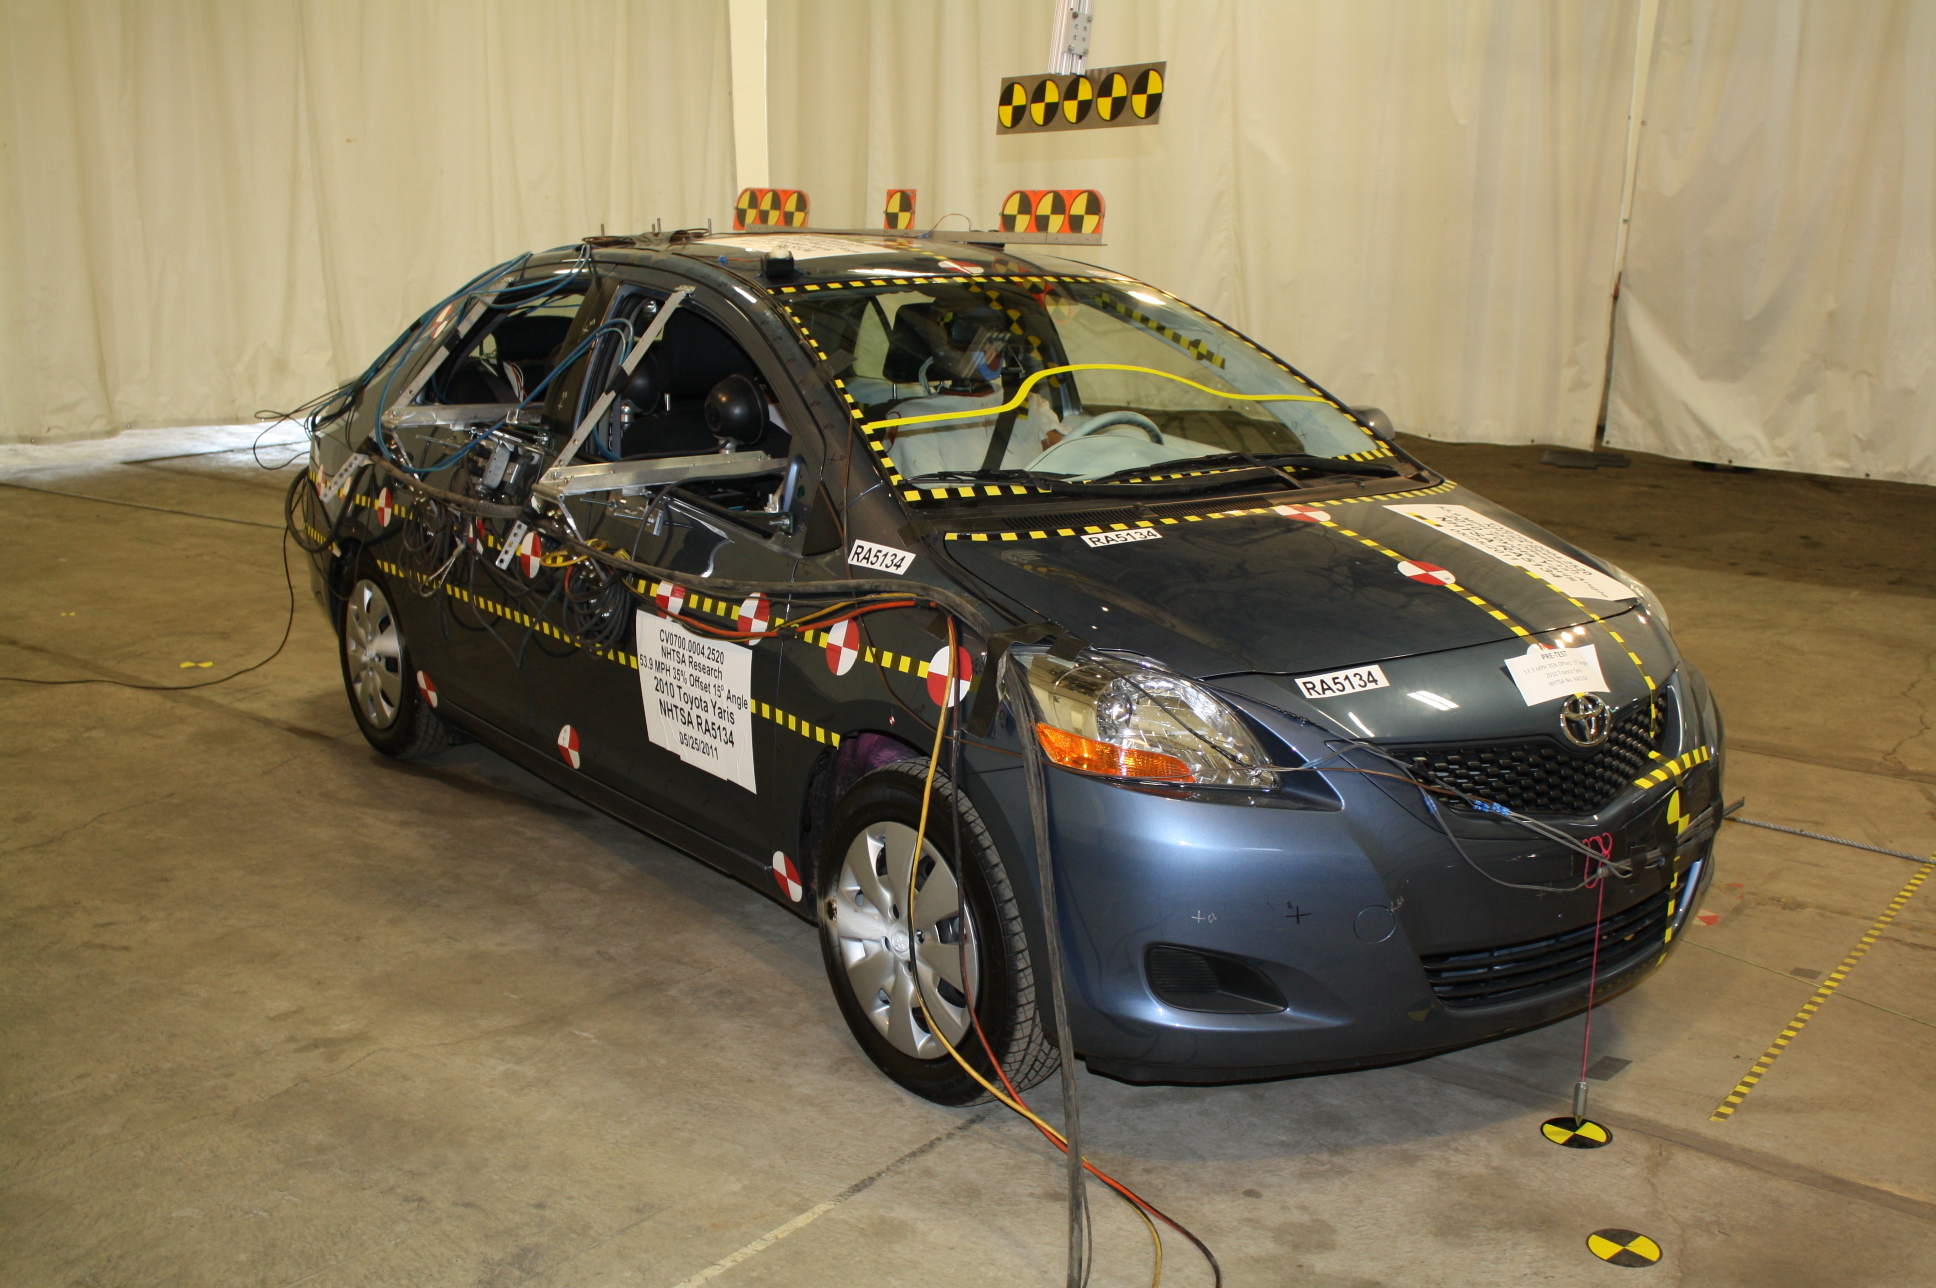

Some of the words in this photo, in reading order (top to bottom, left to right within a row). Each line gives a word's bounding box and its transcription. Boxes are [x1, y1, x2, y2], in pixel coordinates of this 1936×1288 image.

[1088, 530, 1158, 546] RA5134
[851, 545, 906, 571] RA5134
[659, 629, 724, 665] CV0700.0004.2520
[661, 645, 687, 667] NHTSA
[688, 655, 723, 681] Research
[1541, 651, 1568, 660] PRE-TEST
[639, 654, 653, 670] 53.9
[655, 659, 671, 678] MPH
[672, 667, 687, 685] 35%
[689, 673, 711, 694] Offset
[726, 689, 748, 710] Angle
[1302, 670, 1379, 696] RA5134
[654, 676, 675, 698] 2010
[676, 685, 708, 714] Toyota
[710, 699, 735, 725] Yaris
[659, 698, 694, 730] NHTSA
[696, 714, 734, 748] RA5134
[679, 731, 719, 760] 05/25/2011
